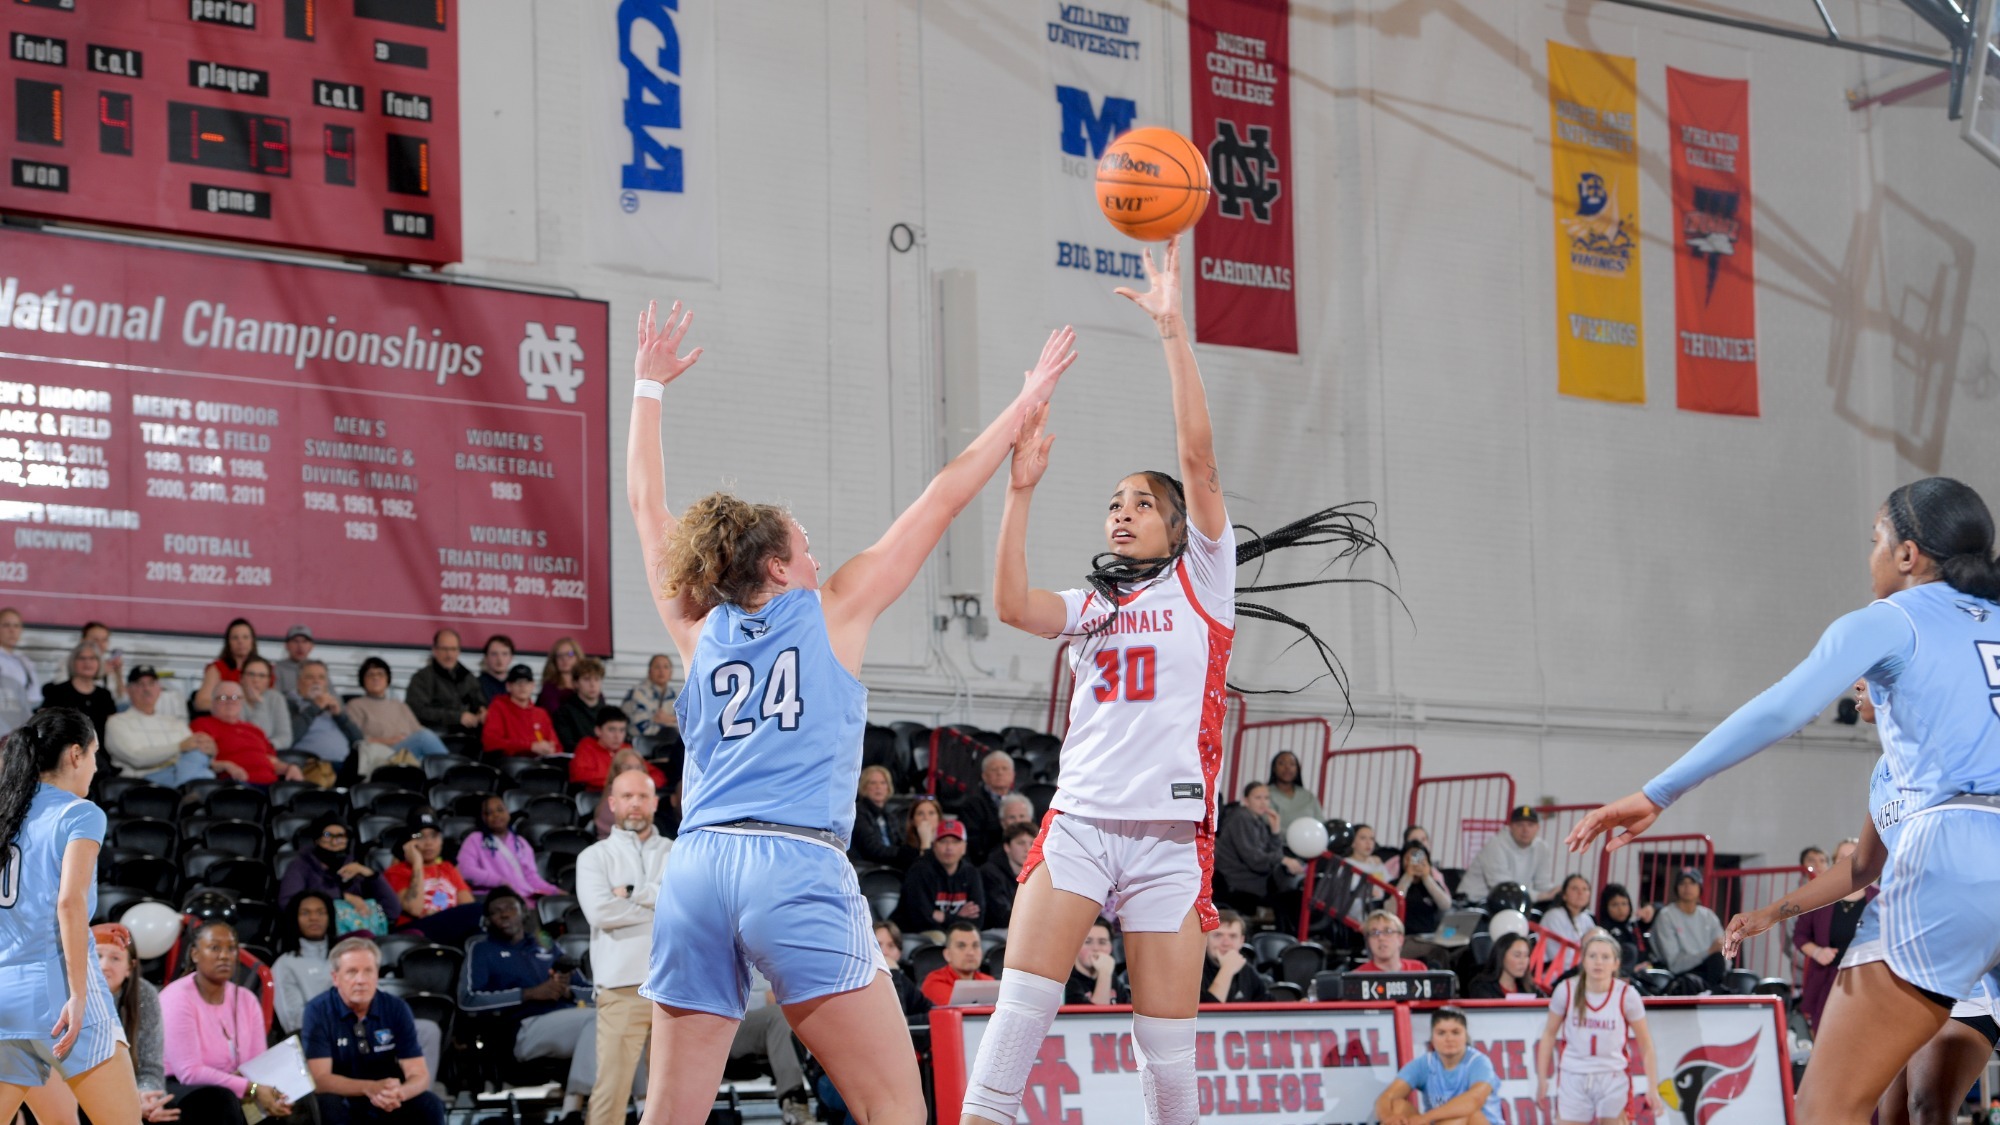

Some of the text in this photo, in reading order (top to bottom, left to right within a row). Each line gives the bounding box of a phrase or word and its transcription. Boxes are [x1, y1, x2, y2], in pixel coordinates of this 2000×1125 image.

[1059, 5, 1129, 35] MILLIKIN
[15, 36, 63, 64] fouls
[1047, 23, 1140, 61] UNIVERSITY
[1216, 31, 1266, 59] NORTH
[198, 65, 260, 92] player
[1207, 52, 1278, 84] CENTRAL
[617, 0, 683, 193] CAA
[1212, 76, 1274, 106] COLLEGE
[386, 93, 429, 119] fouls
[23, 166, 60, 187] won
[1101, 152, 1161, 178] Wilson
[208, 187, 255, 213] game
[393, 214, 426, 234] won
[1057, 242, 1145, 280] BIG BLUE
[1201, 257, 1291, 290] CARDINALS
[0, 276, 484, 385] National Championships
[1568, 313, 1638, 347] VIKINGS
[38, 385, 111, 413] INDOOR
[132, 394, 279, 427] MEN'S OUTDOOR
[40, 413, 57, 436] &
[60, 414, 112, 440] FIELD
[140, 422, 271, 452] TRACK & FIELD
[334, 415, 387, 438] MEN'S
[466, 428, 544, 452] WOMEN'S
[304, 438, 415, 467] SWIMMING &
[455, 453, 555, 479] BASKETBALL
[302, 464, 419, 495] DIVING (NAIA)
[164, 533, 253, 558] FOOTBALL
[470, 525, 548, 548] WOMEN'S
[438, 548, 579, 575] TRIATHLON (USAT)
[1091, 644, 1157, 704] 30
[711, 646, 804, 741] 24
[1386, 981, 1408, 1000] poss
[1225, 1028, 1389, 1072] CENTRAL
[1590, 1034, 1598, 1057] 1
[1198, 1072, 1326, 1115] OLLEGE
